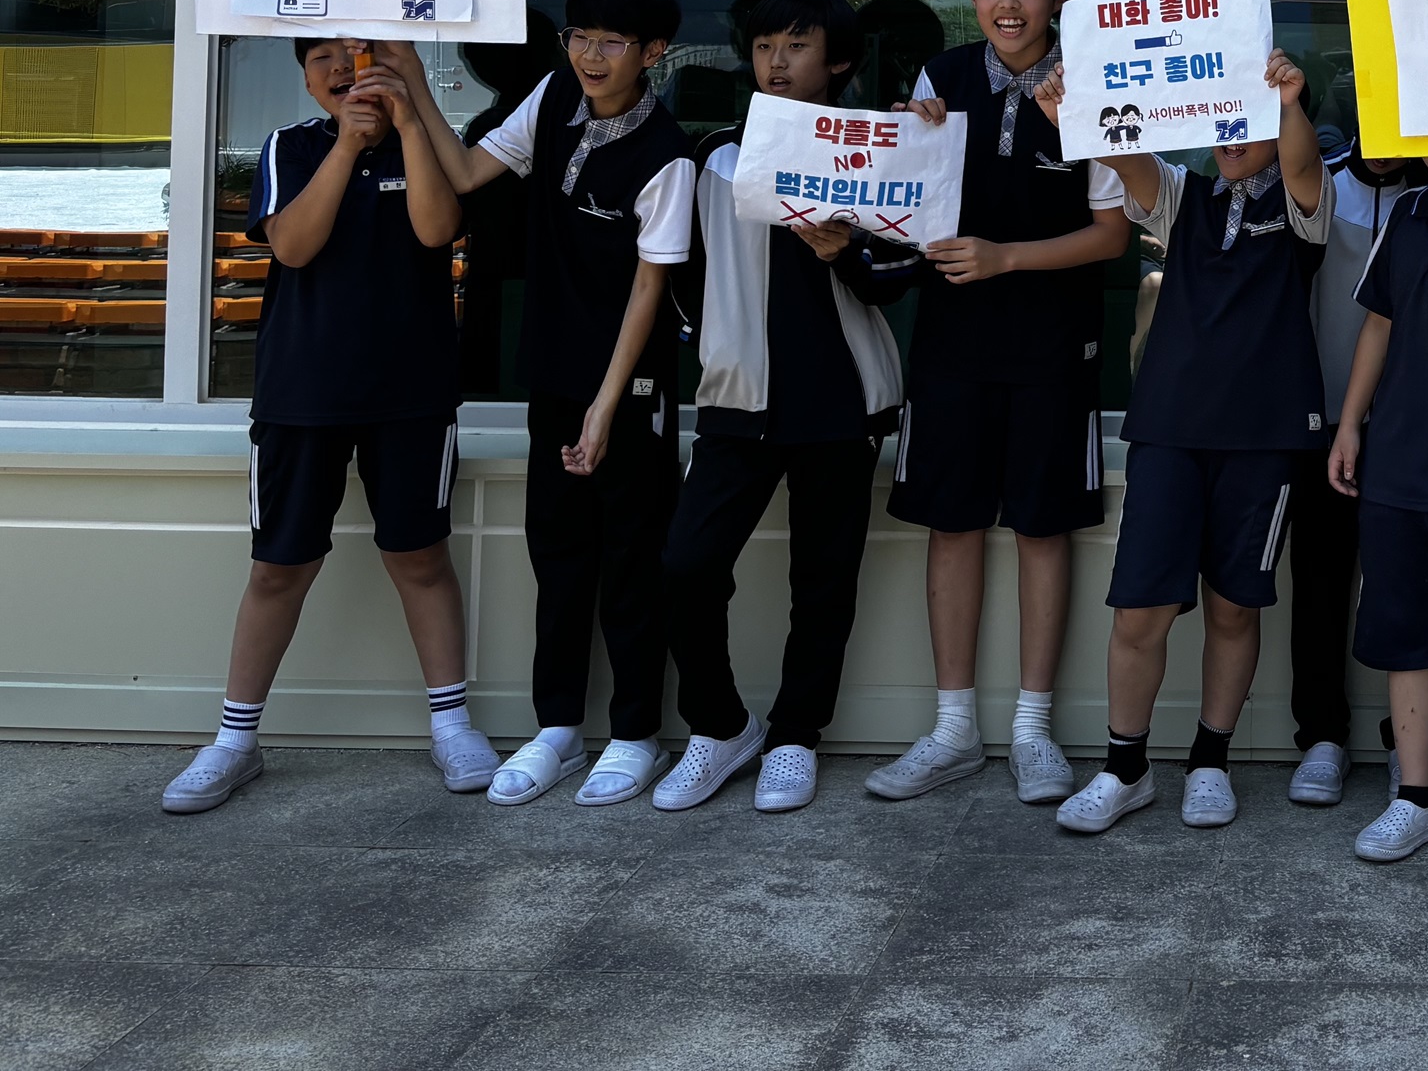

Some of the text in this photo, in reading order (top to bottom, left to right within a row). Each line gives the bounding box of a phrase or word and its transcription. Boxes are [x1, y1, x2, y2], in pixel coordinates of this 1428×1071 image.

[1097, 0, 1151, 29] 대화
[1103, 51, 1225, 90] 친구 좋아!
[1148, 99, 1244, 122] 사이버폭력 NO!!
[814, 116, 900, 148] 악플도
[833, 150, 874, 173] NO!
[775, 171, 924, 208] 범죄입니다!
